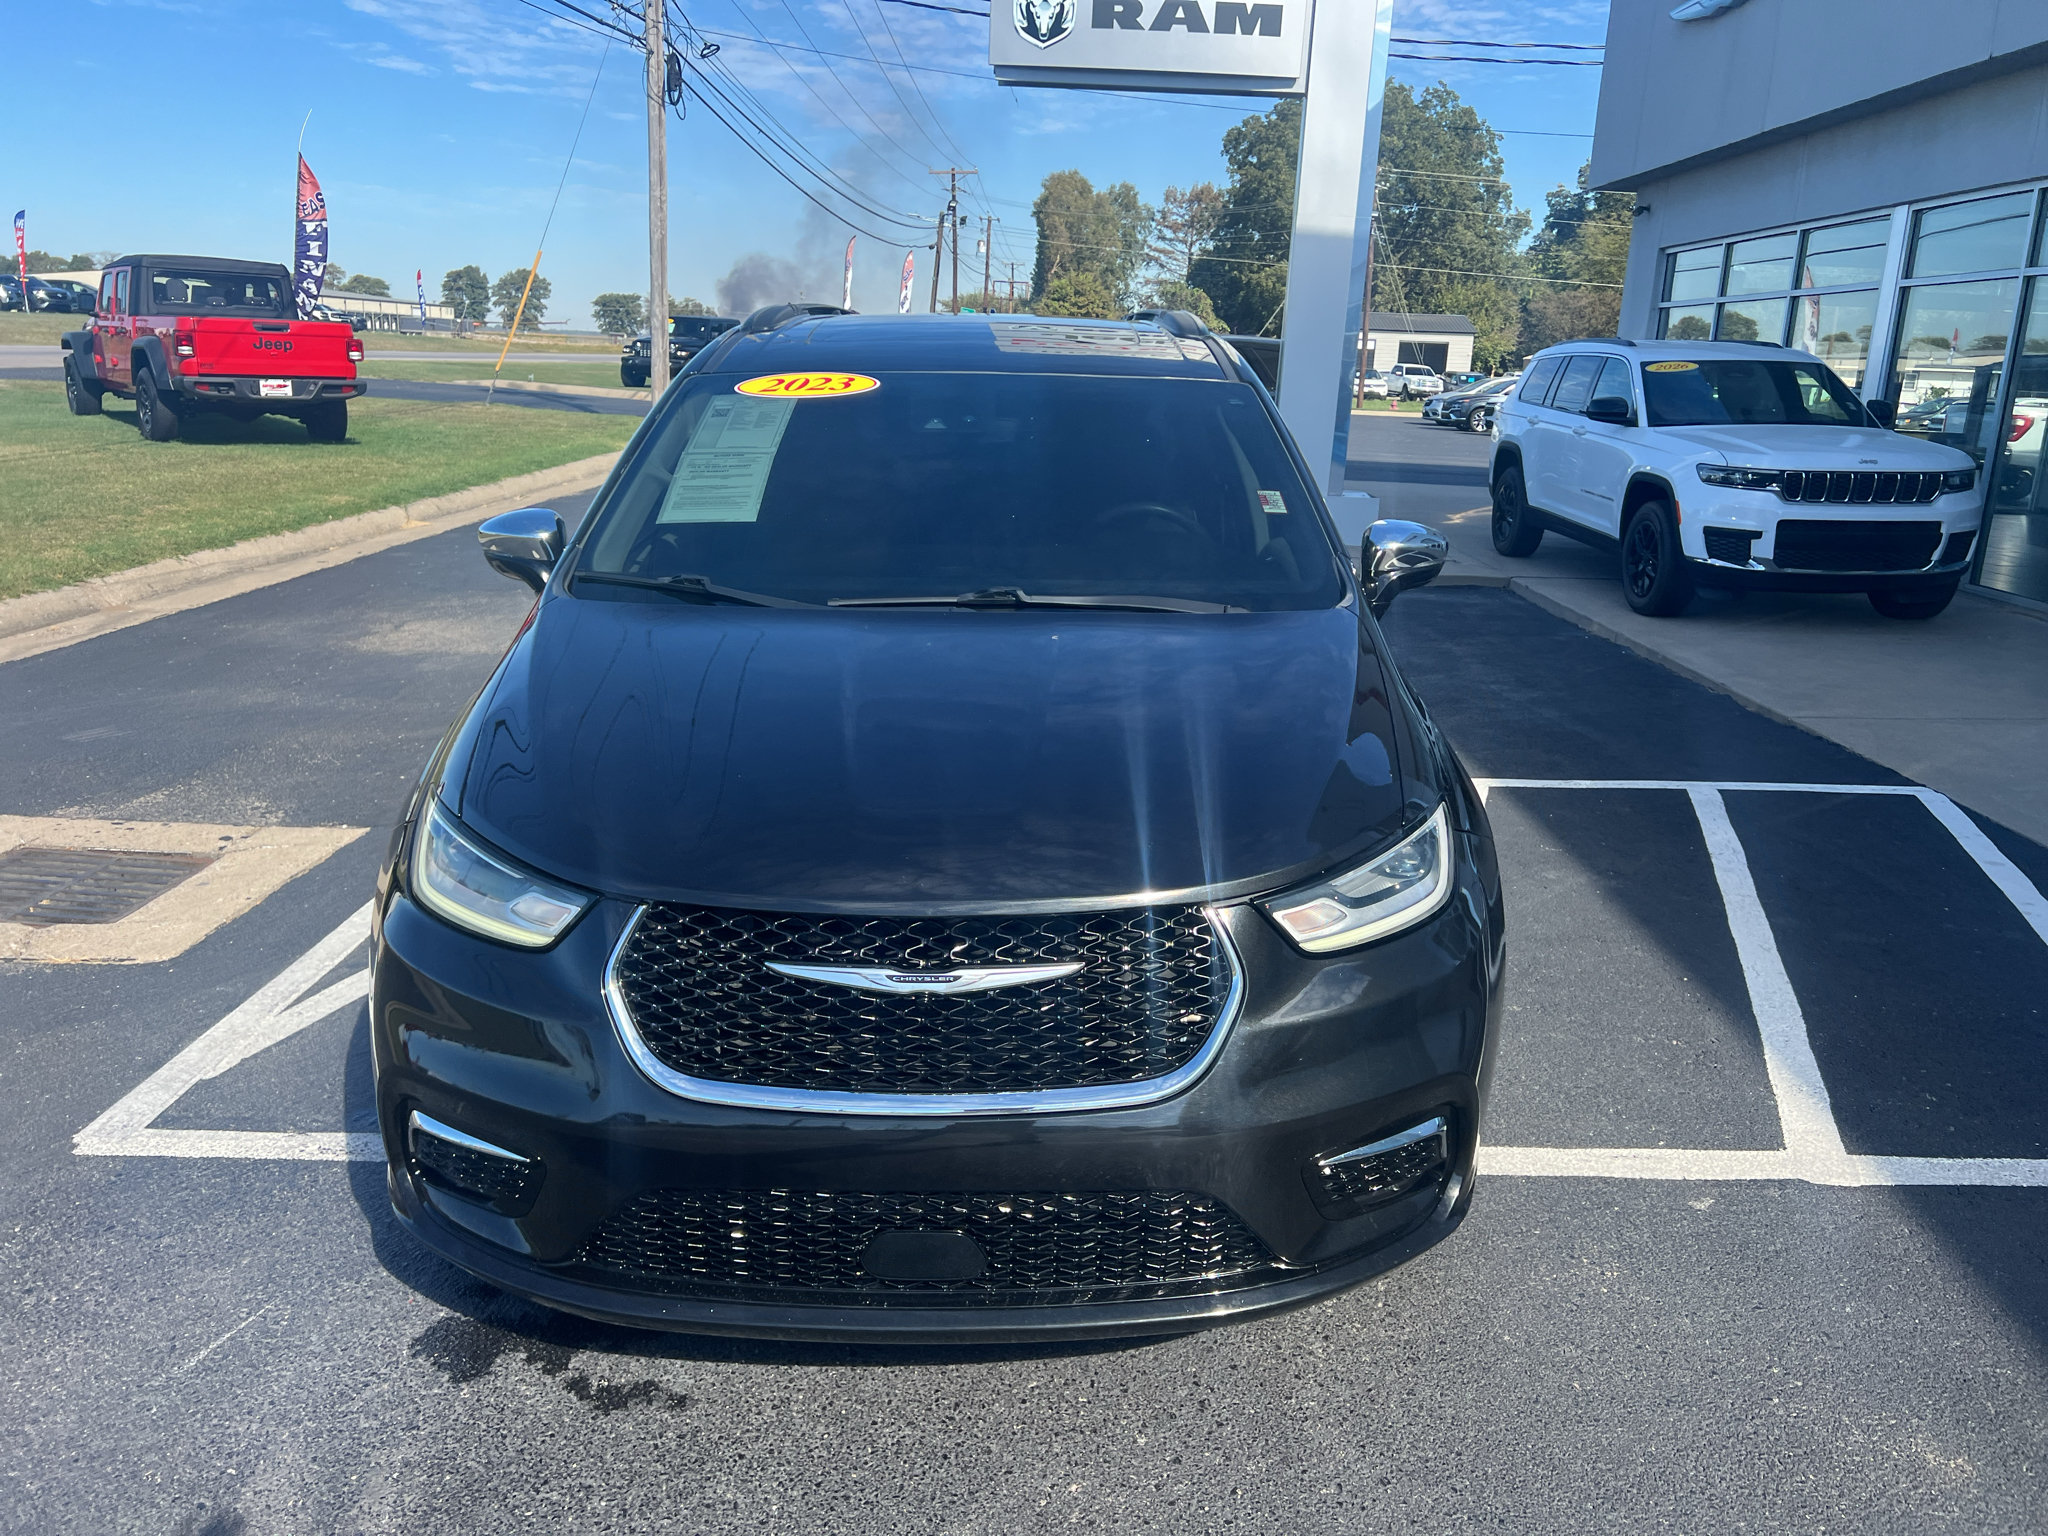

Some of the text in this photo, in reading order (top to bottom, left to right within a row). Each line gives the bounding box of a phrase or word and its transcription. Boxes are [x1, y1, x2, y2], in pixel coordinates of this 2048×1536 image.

[1091, 0, 1283, 37] RAM
[252, 336, 293, 353] Jeep
[1655, 363, 1689, 371] 2026
[758, 377, 855, 392] 2023
